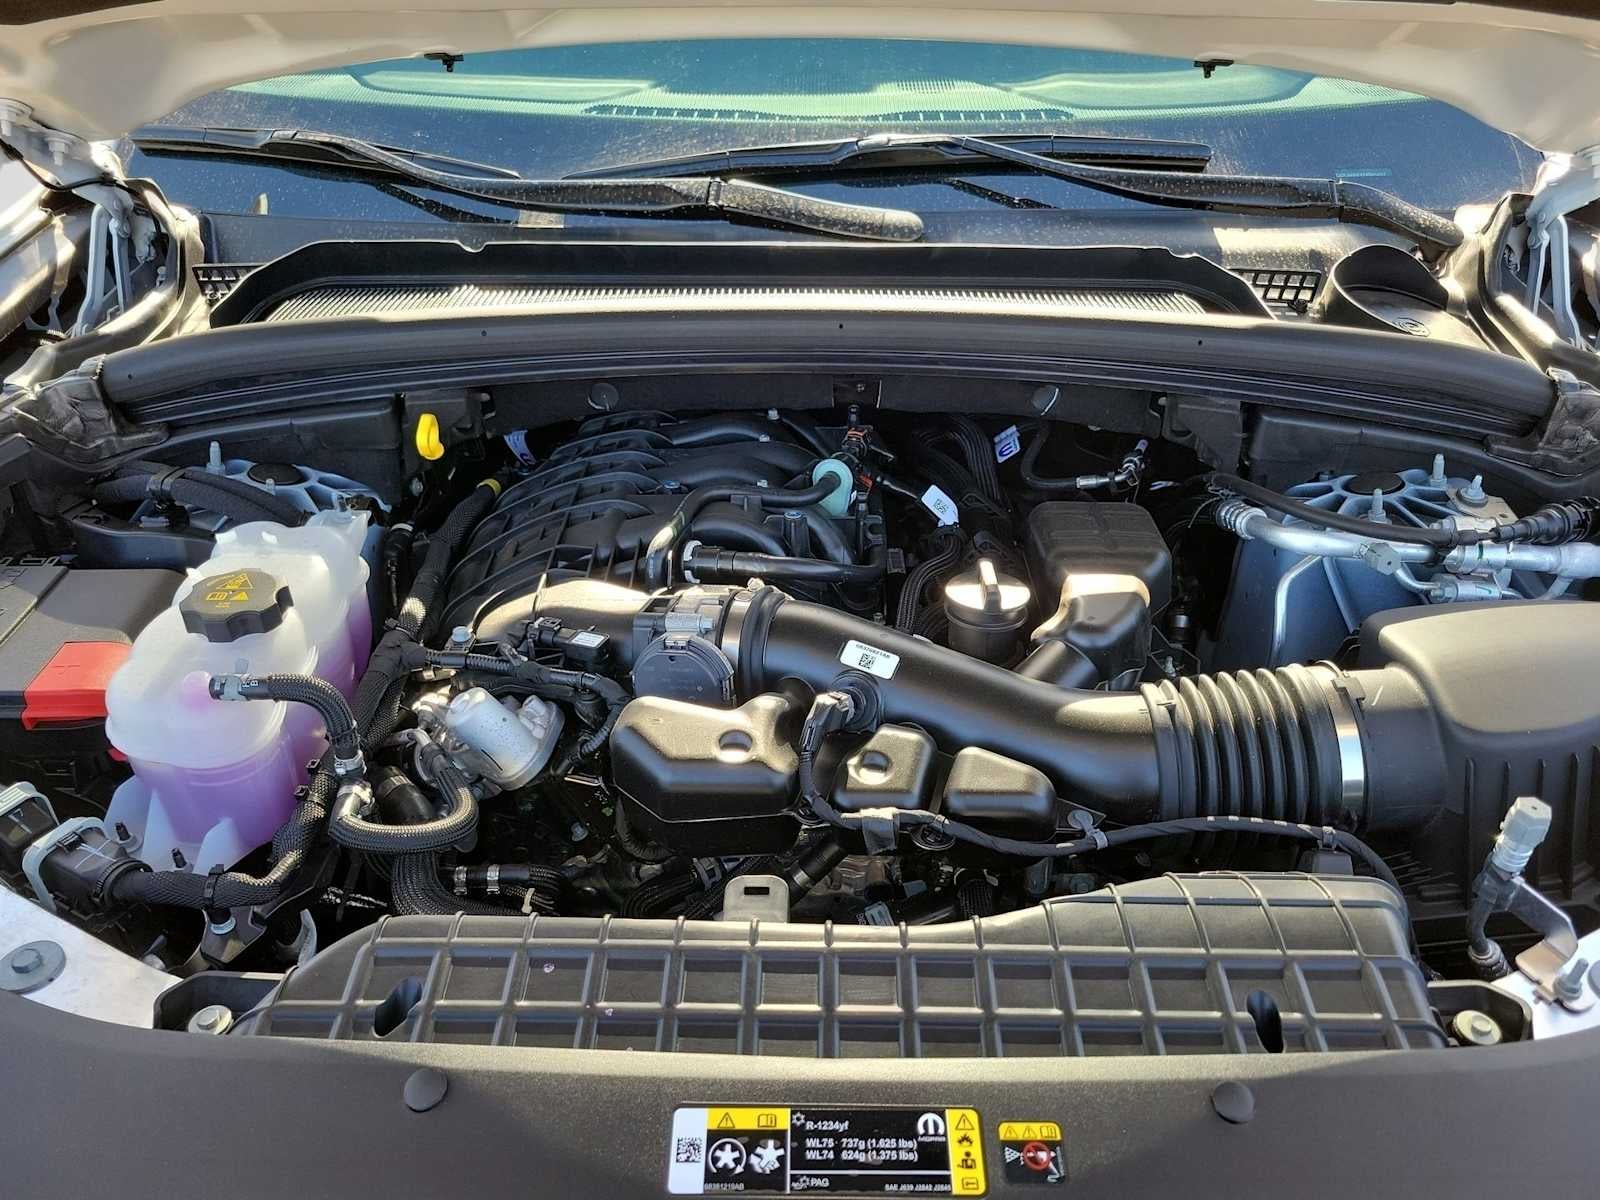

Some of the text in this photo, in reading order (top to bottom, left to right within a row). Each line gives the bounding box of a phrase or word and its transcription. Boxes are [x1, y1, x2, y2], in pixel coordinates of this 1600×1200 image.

[805, 1121, 849, 1132] R-1234yf
[805, 1138, 918, 1150] WL75 737g (1.625 lbs)
[805, 1150, 919, 1162] WL74 624g (1.375 lbs)
[811, 1177, 829, 1187] PAG
